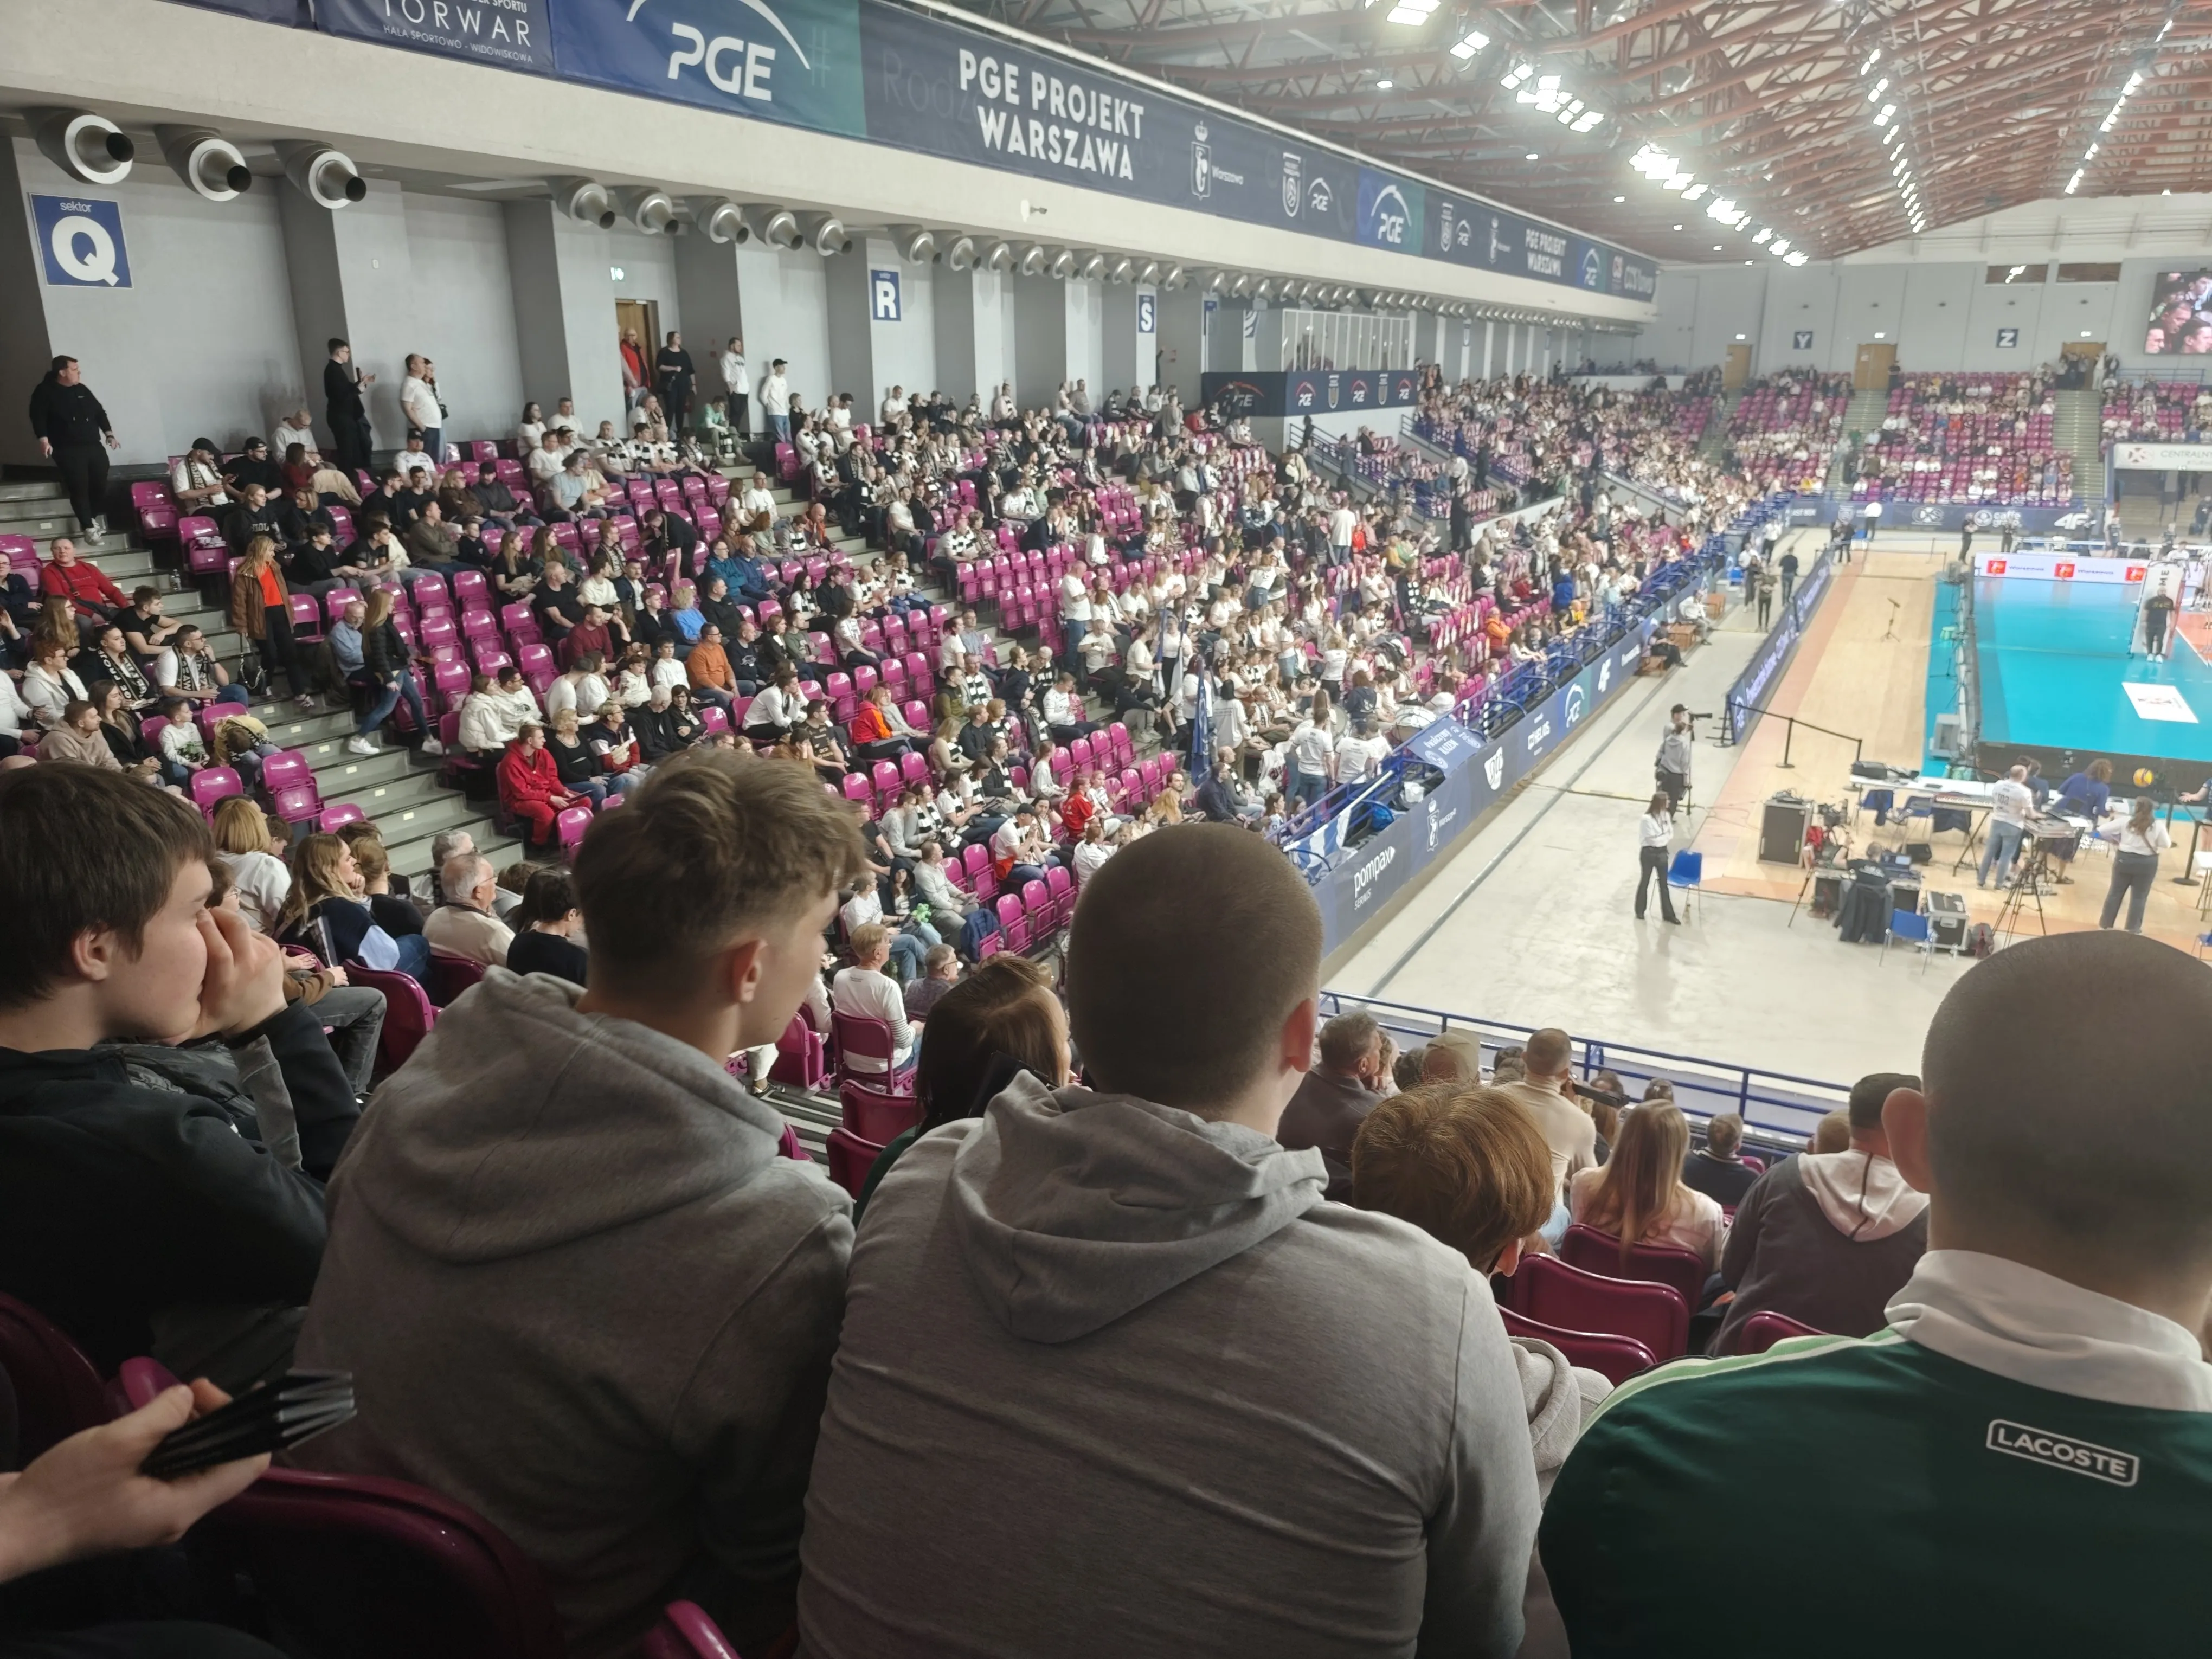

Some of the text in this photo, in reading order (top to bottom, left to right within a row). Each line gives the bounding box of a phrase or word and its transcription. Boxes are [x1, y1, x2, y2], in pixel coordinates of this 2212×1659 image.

[383, 25, 409, 38] HALA
[410, 30, 462, 49] SPORTOWO
[469, 43, 533, 63] WIDOWISKOWA
[667, 22, 776, 101] PGE
[960, 48, 1144, 139] PGE PROJEKT
[978, 105, 1134, 180] WARSZAWA
[60, 201, 92, 213] sektor
[1311, 192, 1328, 211] PGE
[1378, 213, 1404, 244] PGE
[52, 216, 119, 286] Q
[876, 280, 897, 318] R
[1141, 302, 1153, 331] S
[1797, 335, 1810, 349] Y
[1999, 332, 2015, 347] Z
[1354, 850, 1391, 898] pompax
[1997, 1428, 2127, 1478] LACOSTE
